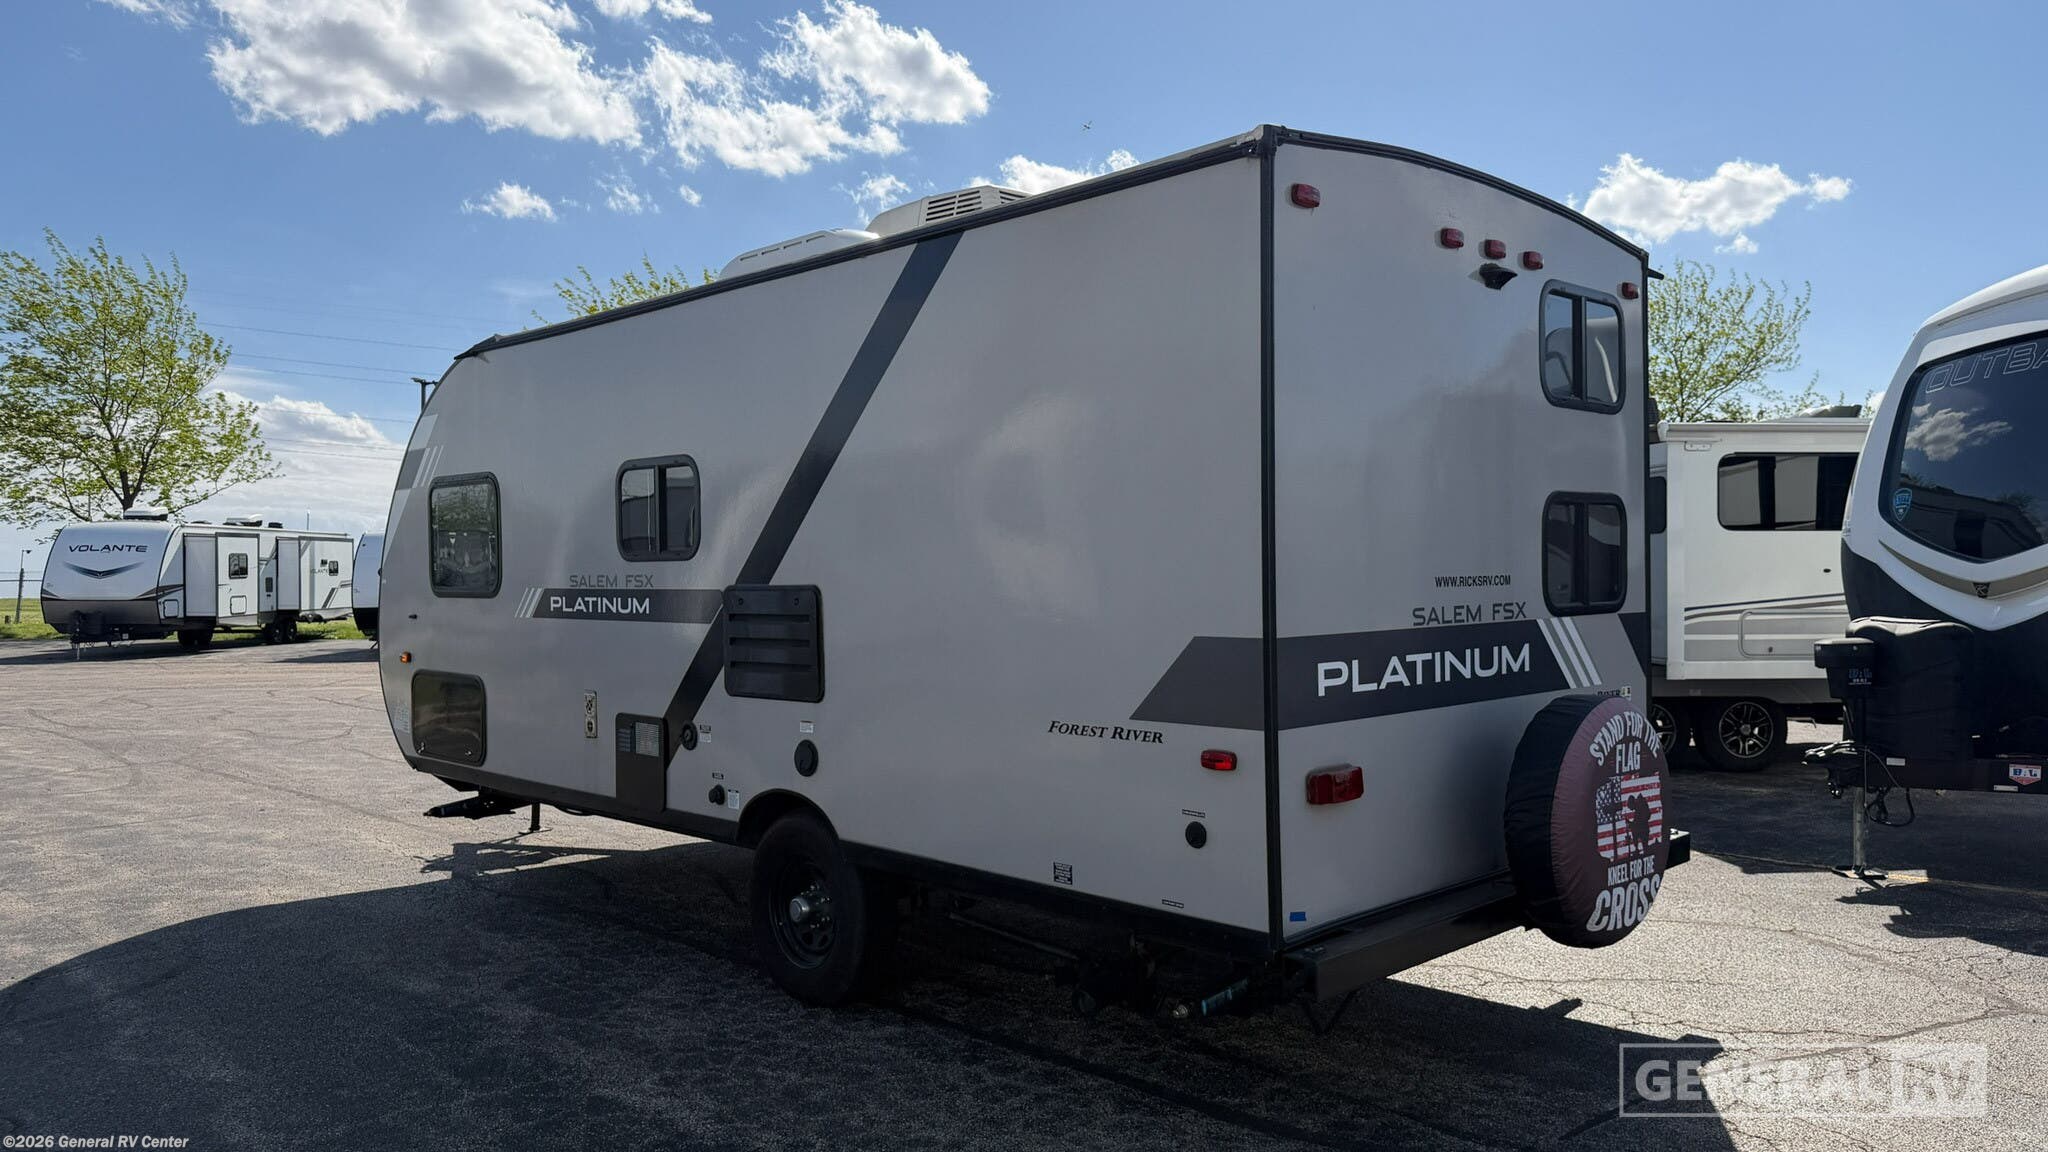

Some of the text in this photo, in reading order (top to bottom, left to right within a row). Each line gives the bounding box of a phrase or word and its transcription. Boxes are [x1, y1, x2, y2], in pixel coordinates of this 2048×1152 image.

[68, 544, 148, 553] VOLANTE
[569, 574, 654, 589] SALEM FSX
[1435, 574, 1511, 588] WWW.RICKSRV.COM
[549, 596, 650, 615] PLATINUM
[1413, 601, 1527, 626] SALEM FSX
[1317, 643, 1531, 697] PLATINUM
[1048, 720, 1163, 744] FOREST RIVER
[1589, 711, 1661, 766] STAND FOR THE
[1615, 741, 1641, 774] FLAG
[1607, 854, 1655, 887] KNEEL FOR THE
[1586, 873, 1661, 932] CROSS
